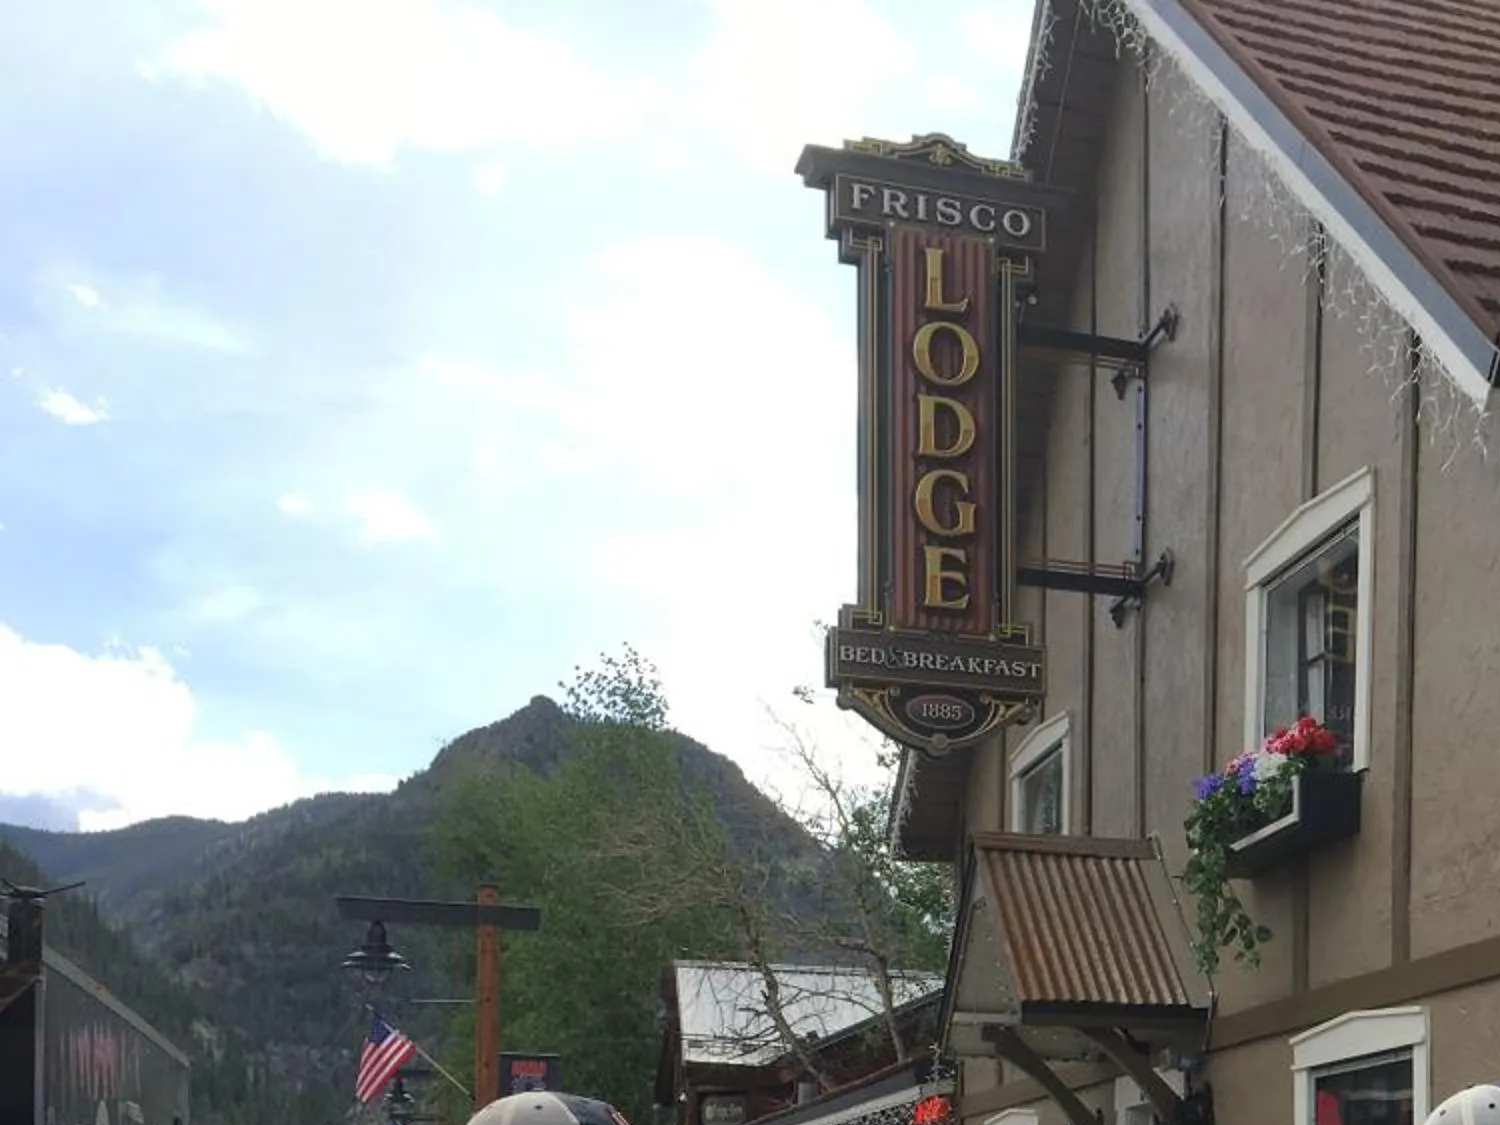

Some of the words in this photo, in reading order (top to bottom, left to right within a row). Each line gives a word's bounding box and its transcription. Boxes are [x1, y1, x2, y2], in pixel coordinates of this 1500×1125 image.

[851, 182, 1032, 237] FRISCO
[912, 247, 981, 610] LODGE
[839, 644, 885, 666] BED
[902, 650, 1041, 678] BREAKFAST
[921, 702, 963, 720] 1885
